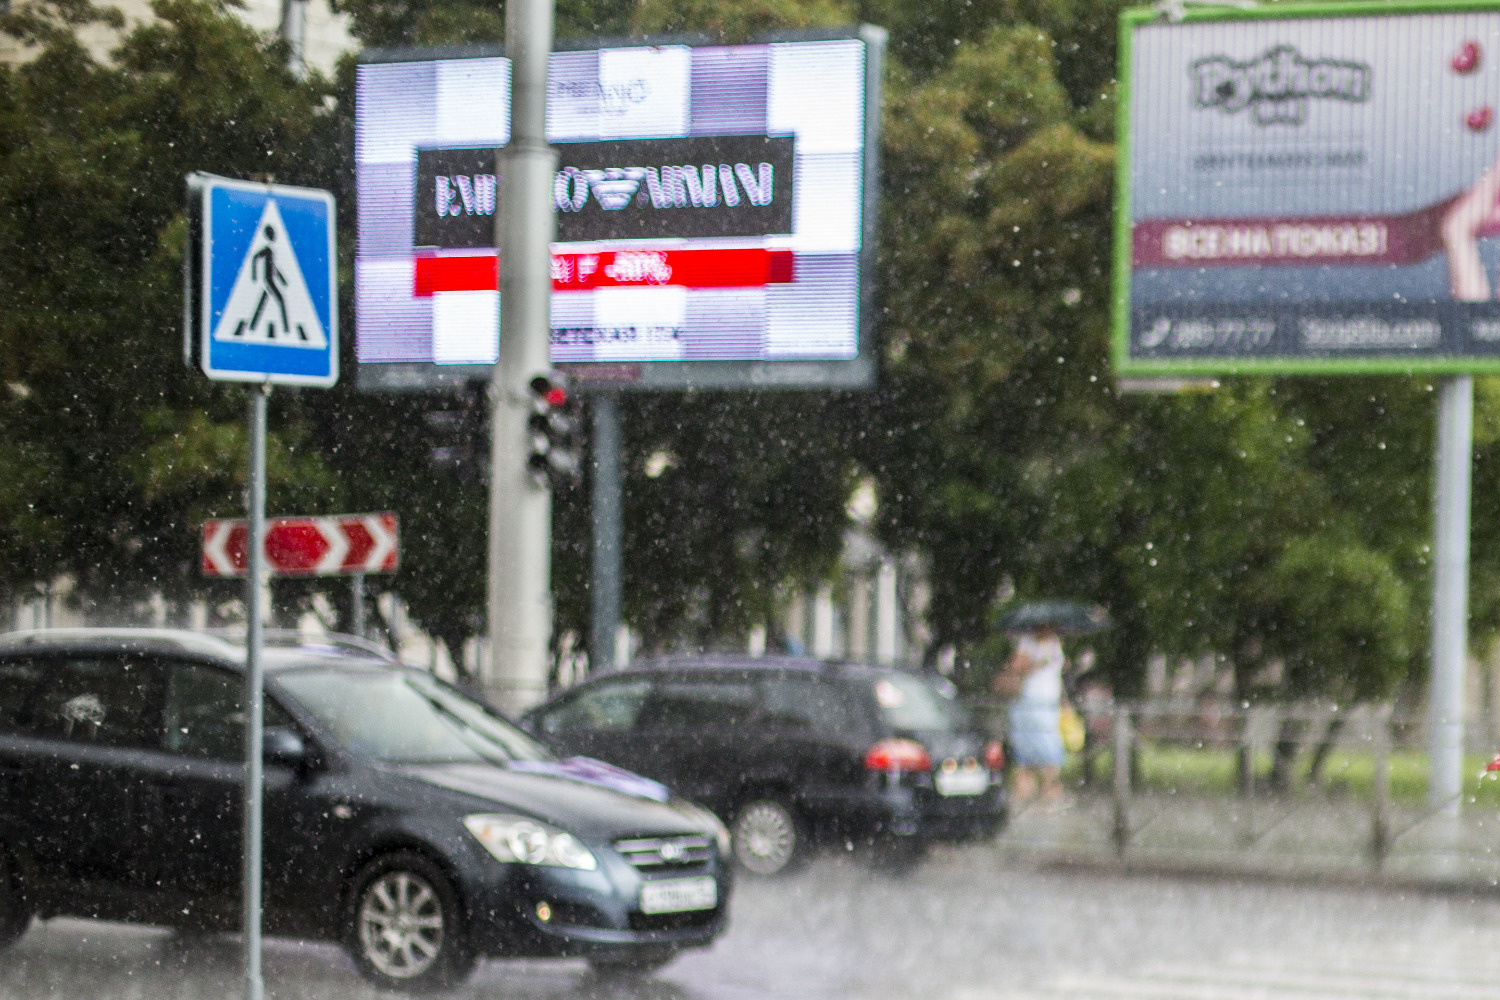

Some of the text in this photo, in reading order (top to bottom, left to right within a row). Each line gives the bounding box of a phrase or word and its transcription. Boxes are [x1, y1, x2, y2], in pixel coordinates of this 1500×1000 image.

[1163, 221, 1388, 259] ВСЕ НА ПОКАЗ!
